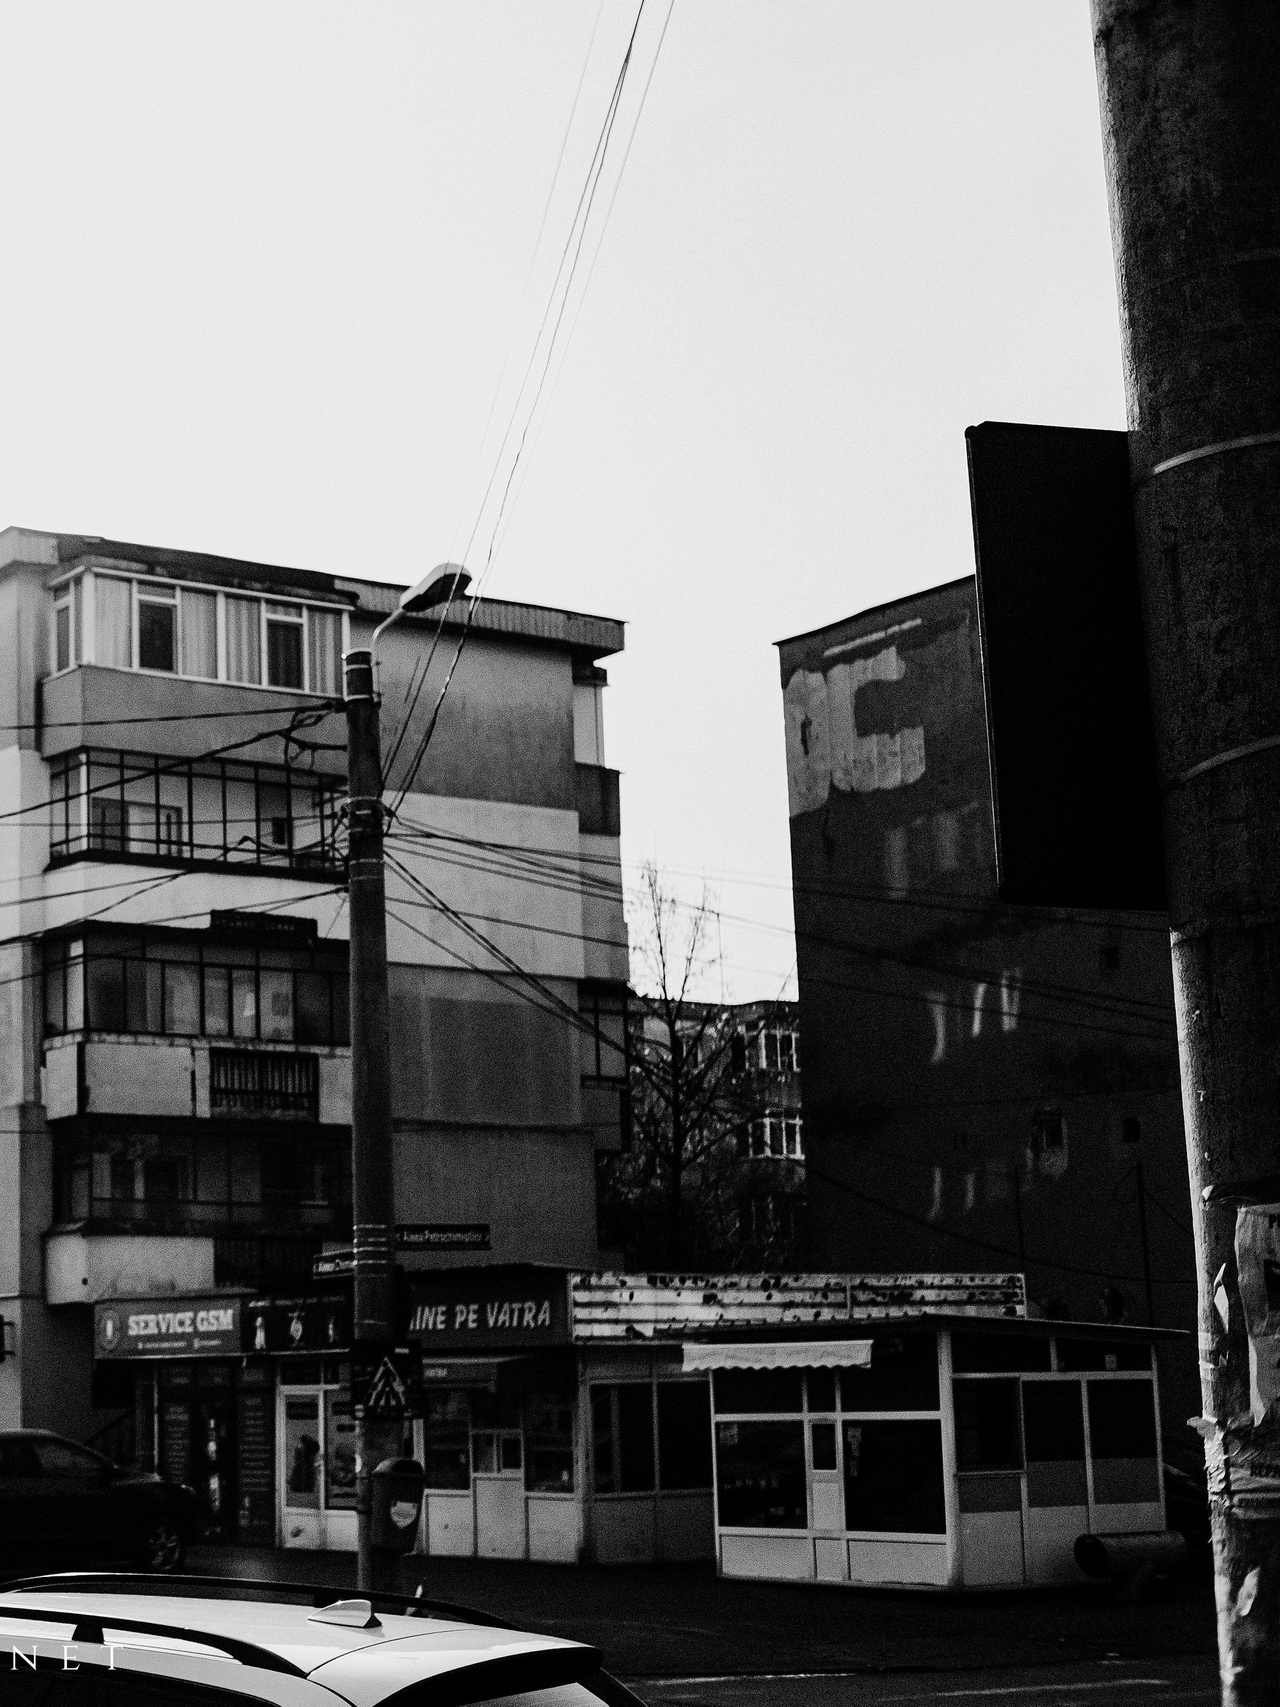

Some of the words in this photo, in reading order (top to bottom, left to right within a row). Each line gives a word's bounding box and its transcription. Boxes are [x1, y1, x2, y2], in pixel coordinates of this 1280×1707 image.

[128, 1311, 194, 1336] SERVICE
[196, 1308, 234, 1332] GSM
[409, 1305, 447, 1331] INE
[455, 1303, 479, 1329] PE
[486, 1300, 551, 1328] VATRA
